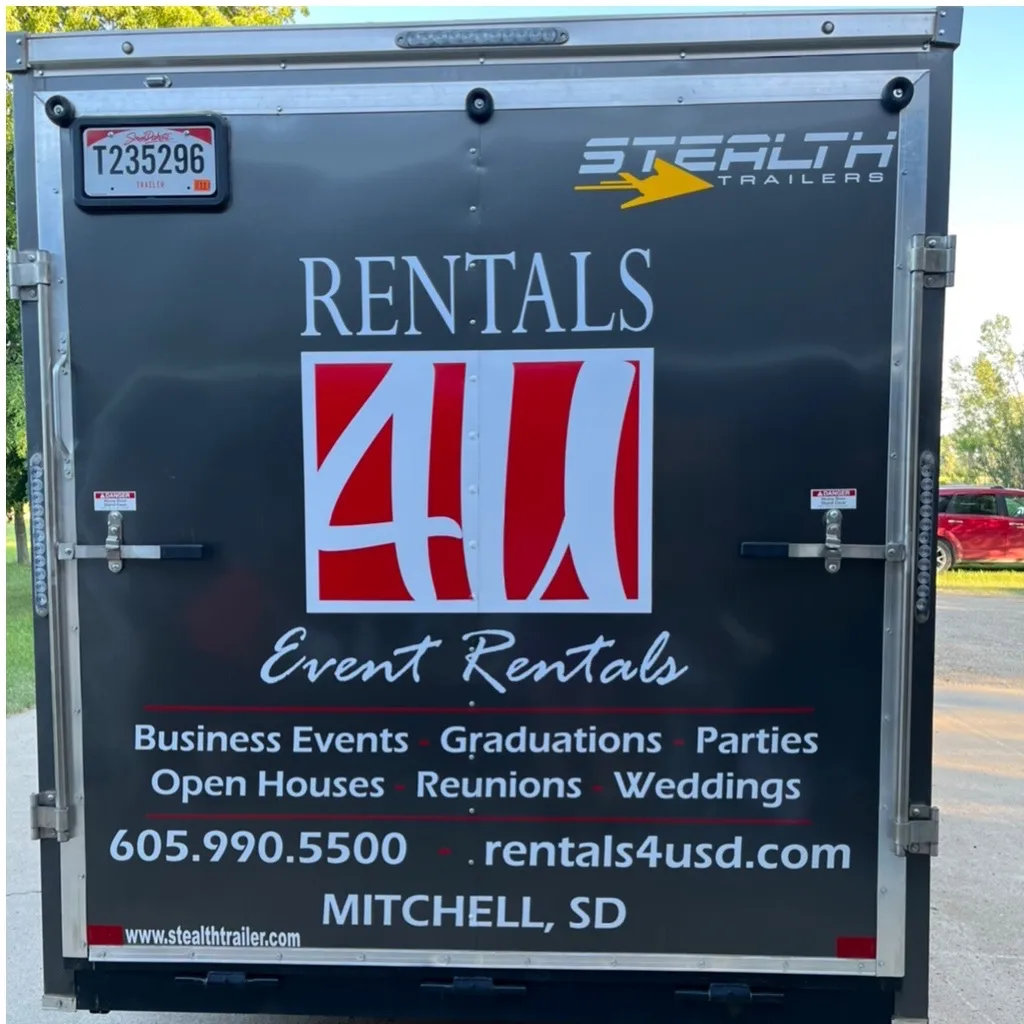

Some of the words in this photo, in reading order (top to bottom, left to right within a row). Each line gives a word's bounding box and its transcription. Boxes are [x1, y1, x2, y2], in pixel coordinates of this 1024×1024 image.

[93, 144, 204, 175] T235296
[579, 131, 897, 175] STEALTH
[718, 172, 884, 186] TRAILERS
[299, 248, 654, 336] RENTALS
[260, 626, 442, 684] Event
[462, 629, 688, 693] Rentals
[134, 724, 281, 753] Business
[292, 726, 409, 753] Events
[440, 725, 662, 754] Graduations
[696, 726, 819, 754] Parties
[151, 768, 246, 803] Open
[259, 771, 385, 798] Houses
[417, 771, 582, 799] Reunions
[613, 771, 801, 808] Weddings
[109, 829, 408, 865] 605.990.5500
[484, 835, 851, 869] rentals4usd.com
[322, 893, 555, 933] MITCHELL,
[569, 897, 627, 929] SD
[125, 925, 301, 947] www.stealthtrailer.com
